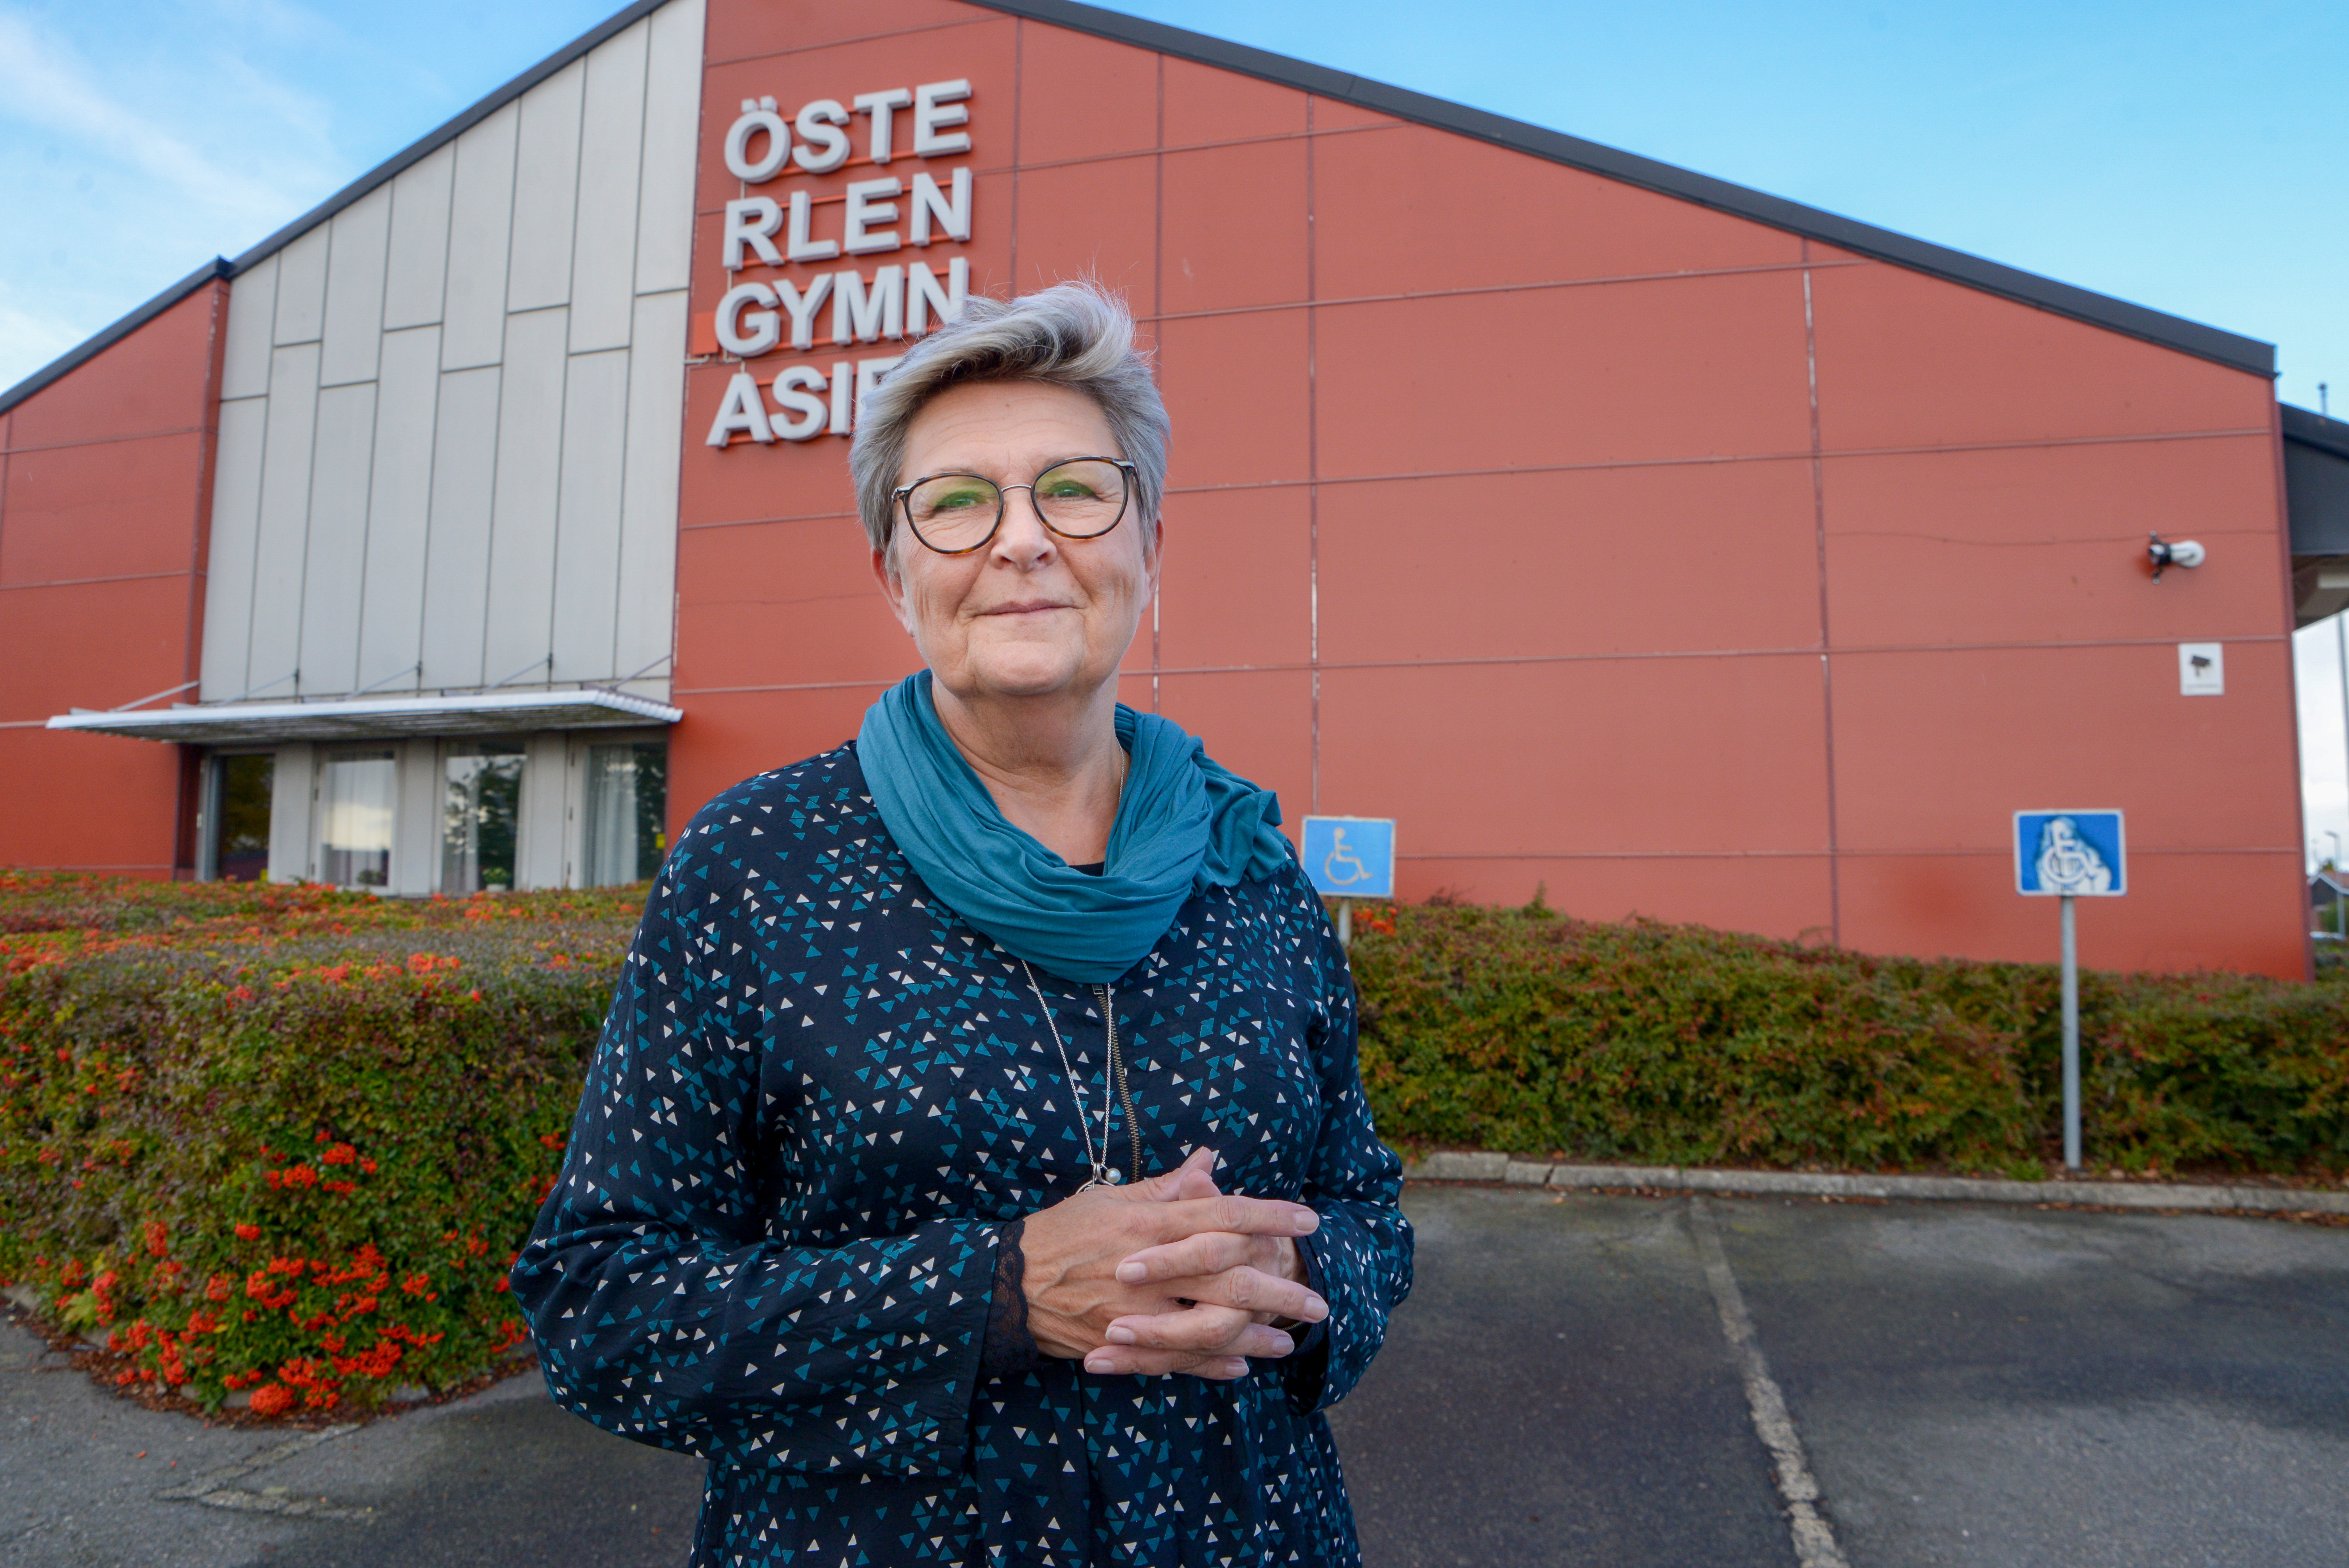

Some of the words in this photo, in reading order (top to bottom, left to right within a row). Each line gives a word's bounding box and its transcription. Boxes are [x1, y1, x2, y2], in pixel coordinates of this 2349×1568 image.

[724, 79, 972, 184] ÖSTE
[722, 167, 973, 271] RLEN
[714, 256, 970, 357] GYMN
